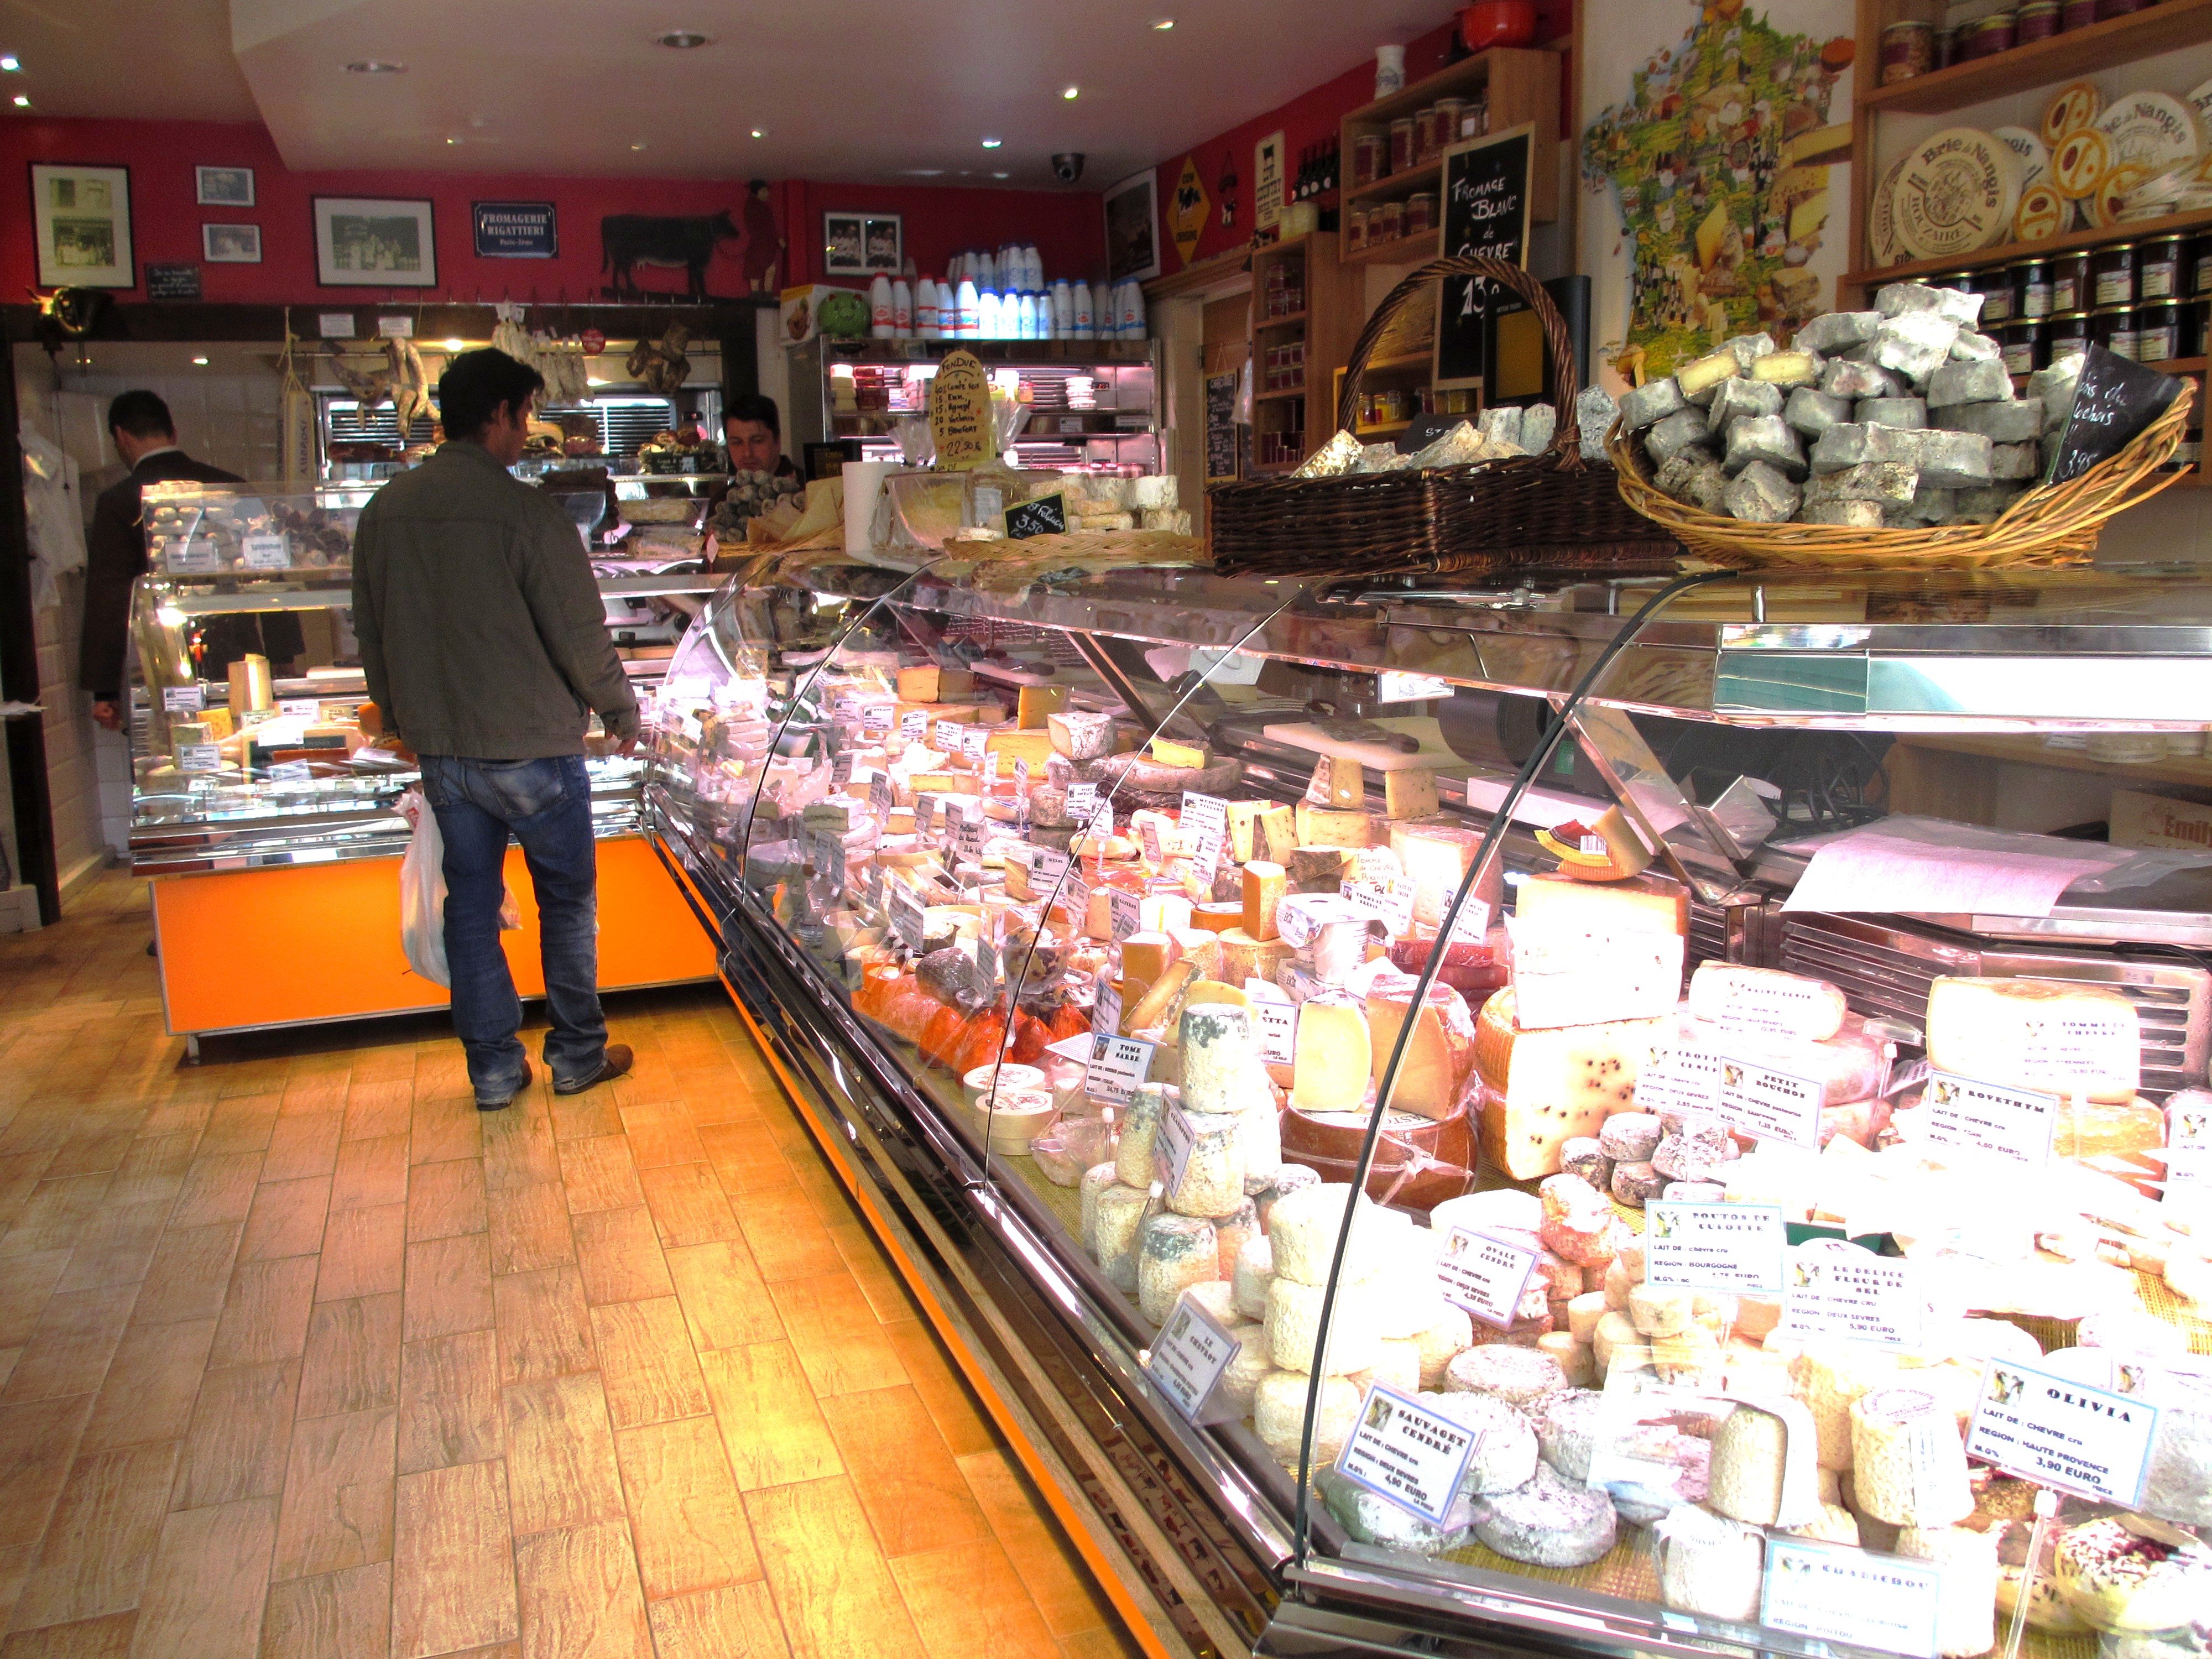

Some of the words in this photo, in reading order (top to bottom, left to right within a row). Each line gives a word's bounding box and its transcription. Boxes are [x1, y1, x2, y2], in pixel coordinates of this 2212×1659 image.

[1922, 139, 1963, 166] Brie
[1971, 143, 1999, 208] Nangis
[1452, 176, 1506, 202] FROMAGE
[1470, 195, 1517, 221] BLANC
[482, 213, 547, 224] FROMAGERIE
[487, 225, 544, 236] RIGATTIERI
[1483, 223, 1494, 239] de
[941, 357, 975, 373] FONDUE
[935, 416, 944, 426] 20
[1199, 804, 1223, 812] VILLAGE
[1354, 853, 1383, 864] TOMME
[1119, 1044, 1141, 1053] TOME
[1115, 1052, 1140, 1062] SARDE
[1678, 1051, 1717, 1062] CROTT
[1764, 1074, 1799, 1088] PETIT
[1756, 1079, 1806, 1099] BOUCHON
[1721, 1102, 1743, 1112] REGION
[1968, 1089, 2045, 1114] ROVETHYM
[1931, 1121, 1957, 1131] REGION
[1964, 1116, 1992, 1126] CHEVRE
[1997, 1146, 2021, 1156] EURO
[1692, 1212, 1747, 1220] BOUTON
[1698, 1223, 1763, 1232] CULOTTE
[1485, 1245, 1516, 1261] OVALE
[1689, 1261, 1738, 1270] BOURGOGNE
[1855, 1267, 1904, 1279] DELICE
[1834, 1275, 1880, 1286] FLEUR
[1477, 1296, 1494, 1307] EURO
[1791, 1308, 1820, 1316] REGION
[1851, 1314, 1880, 1322] SEVRES
[1870, 1326, 1895, 1334] EURO
[1190, 1335, 1217, 1365] CHEVROT
[2046, 1387, 2132, 1423] OLIVIA
[1397, 1409, 1467, 1448] SAUVAGET
[1983, 1407, 2005, 1420] LAIT
[2006, 1415, 2019, 1425] DE
[2026, 1422, 2065, 1441] CHEVRE
[2067, 1437, 2083, 1446] cru
[1359, 1430, 1373, 1442] LAIT
[1402, 1425, 1452, 1455] CENDRÉ
[1979, 1425, 2015, 1443] REGION
[2022, 1440, 2055, 1457] HAUTE
[2057, 1451, 2110, 1475] PROVENCE
[1353, 1446, 1376, 1463] REGION
[1379, 1459, 1396, 1473] DEUX
[2036, 1456, 2063, 1473] 3,90
[2064, 1466, 2102, 1485] EURO
[1385, 1474, 1402, 1488] 4,90
[1404, 1483, 1428, 1501] EURO
